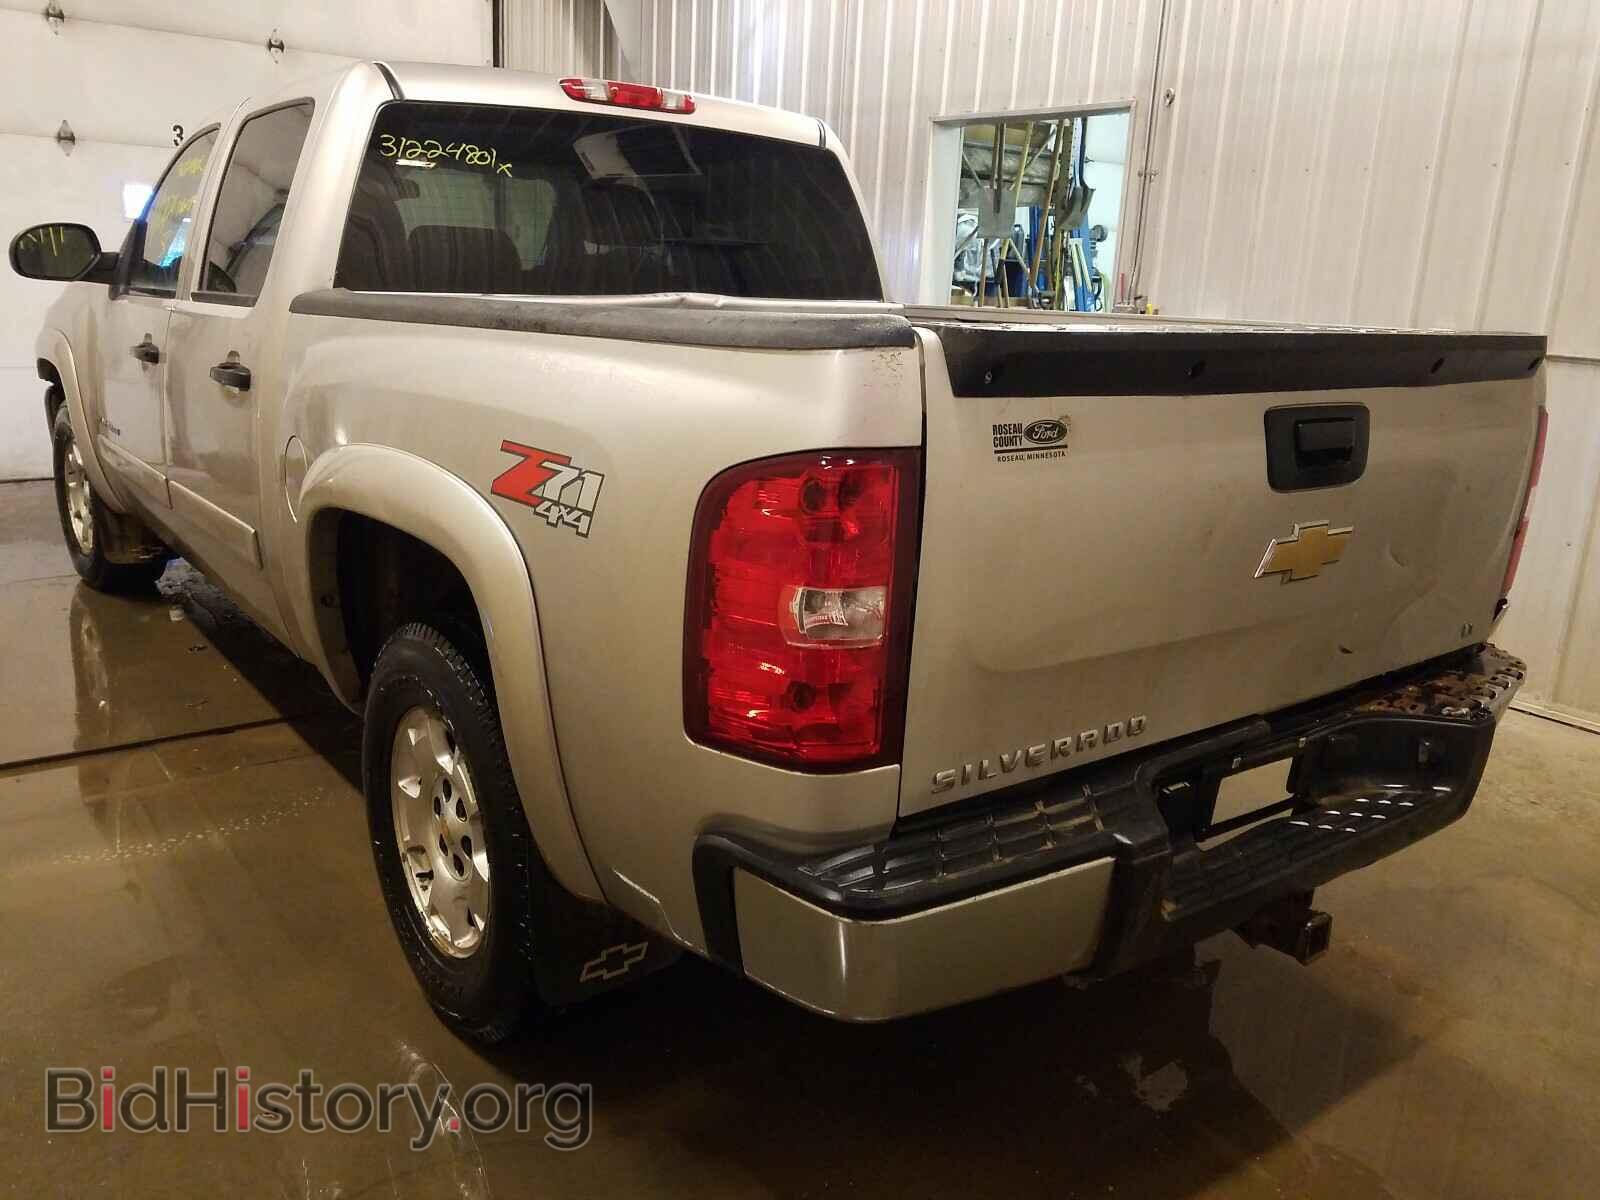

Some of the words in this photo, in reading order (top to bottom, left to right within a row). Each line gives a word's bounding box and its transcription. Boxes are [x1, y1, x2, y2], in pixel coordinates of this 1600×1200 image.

[173, 125, 184, 146] 3
[993, 423, 1023, 436] ROSEAU
[1032, 423, 1059, 439] Ford
[993, 435, 1023, 448] COUNTY
[1026, 450, 1066, 461] MINNESOTA
[491, 439, 605, 515] Z71
[931, 715, 1147, 794] SILVERADO
